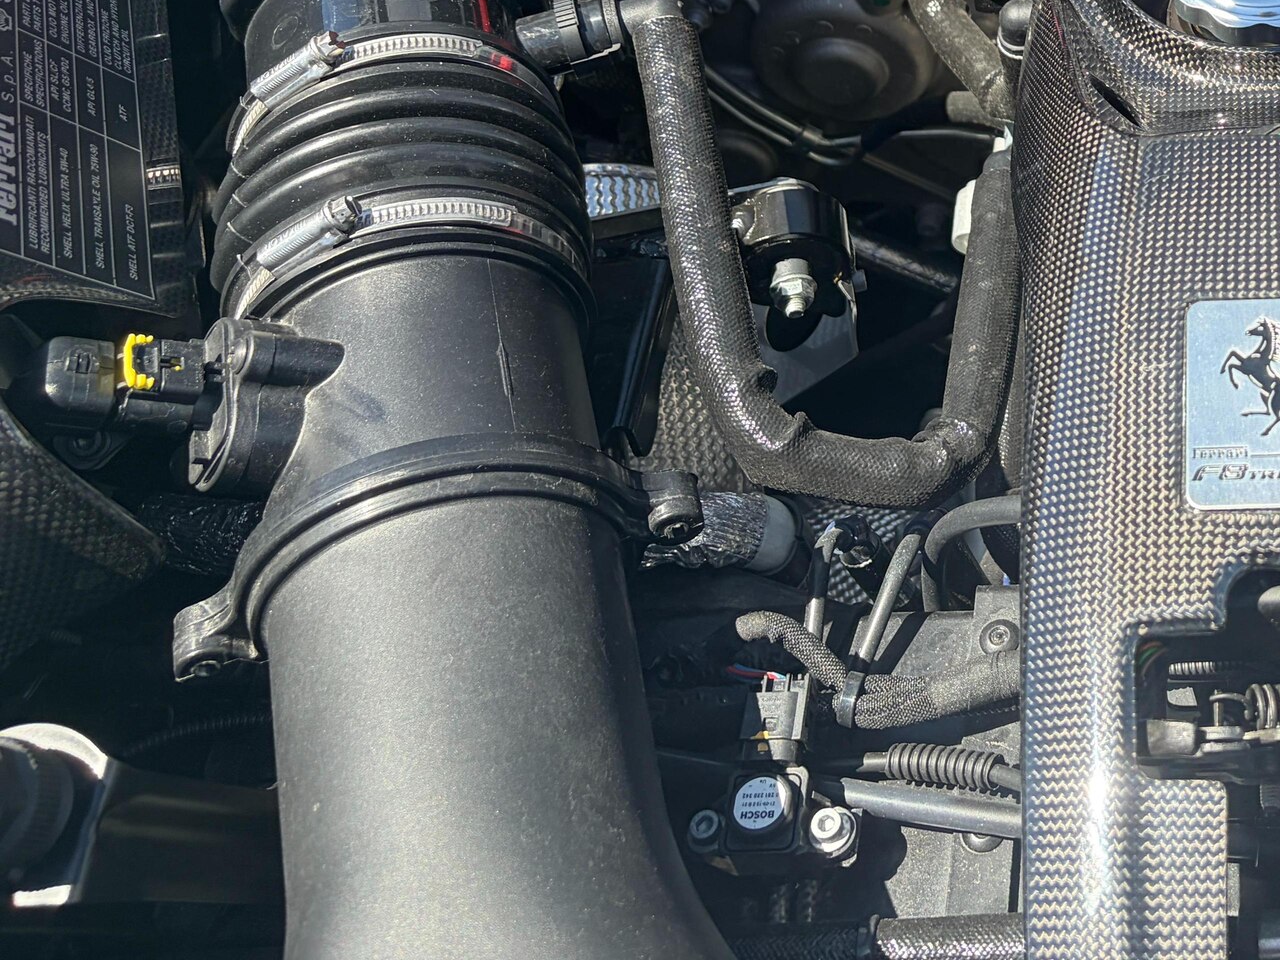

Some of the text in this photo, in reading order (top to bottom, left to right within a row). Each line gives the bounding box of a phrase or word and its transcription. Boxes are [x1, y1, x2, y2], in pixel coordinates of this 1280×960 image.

[22, 2, 31, 27] PARTI
[33, 5, 41, 32] PARTS
[60, 0, 69, 44] ENGINE OIL
[86, 0, 94, 17] AND
[49, 18, 58, 38] OLIO
[88, 19, 97, 58] GEARBOX
[101, 9, 112, 65] OLIO FRIZIONE
[111, 21, 119, 38] AND
[113, 40, 122, 70] CLUTCH
[121, 29, 131, 74] CIRCUIT OIL
[1, 51, 16, 103] S.p.A.
[34, 40, 45, 107] SPECIFICATIONS
[51, 85, 59, 100] API
[88, 101, 96, 116] API
[119, 104, 128, 122] ATF
[26, 115, 38, 248] LUBRIFICANTI RACCOMANDATI
[38, 132, 50, 254] RECOMMENDED LUBRICANTS
[60, 147, 73, 258] SHELL HELIX ULTRA 5W-40
[90, 143, 105, 269] SHELL TRANSAXLE OIL 75W-90
[125, 204, 138, 280] SHELL ATF DCT-F3
[1192, 445, 1248, 459] Ferrari
[740, 810, 775, 819] BOSCH
